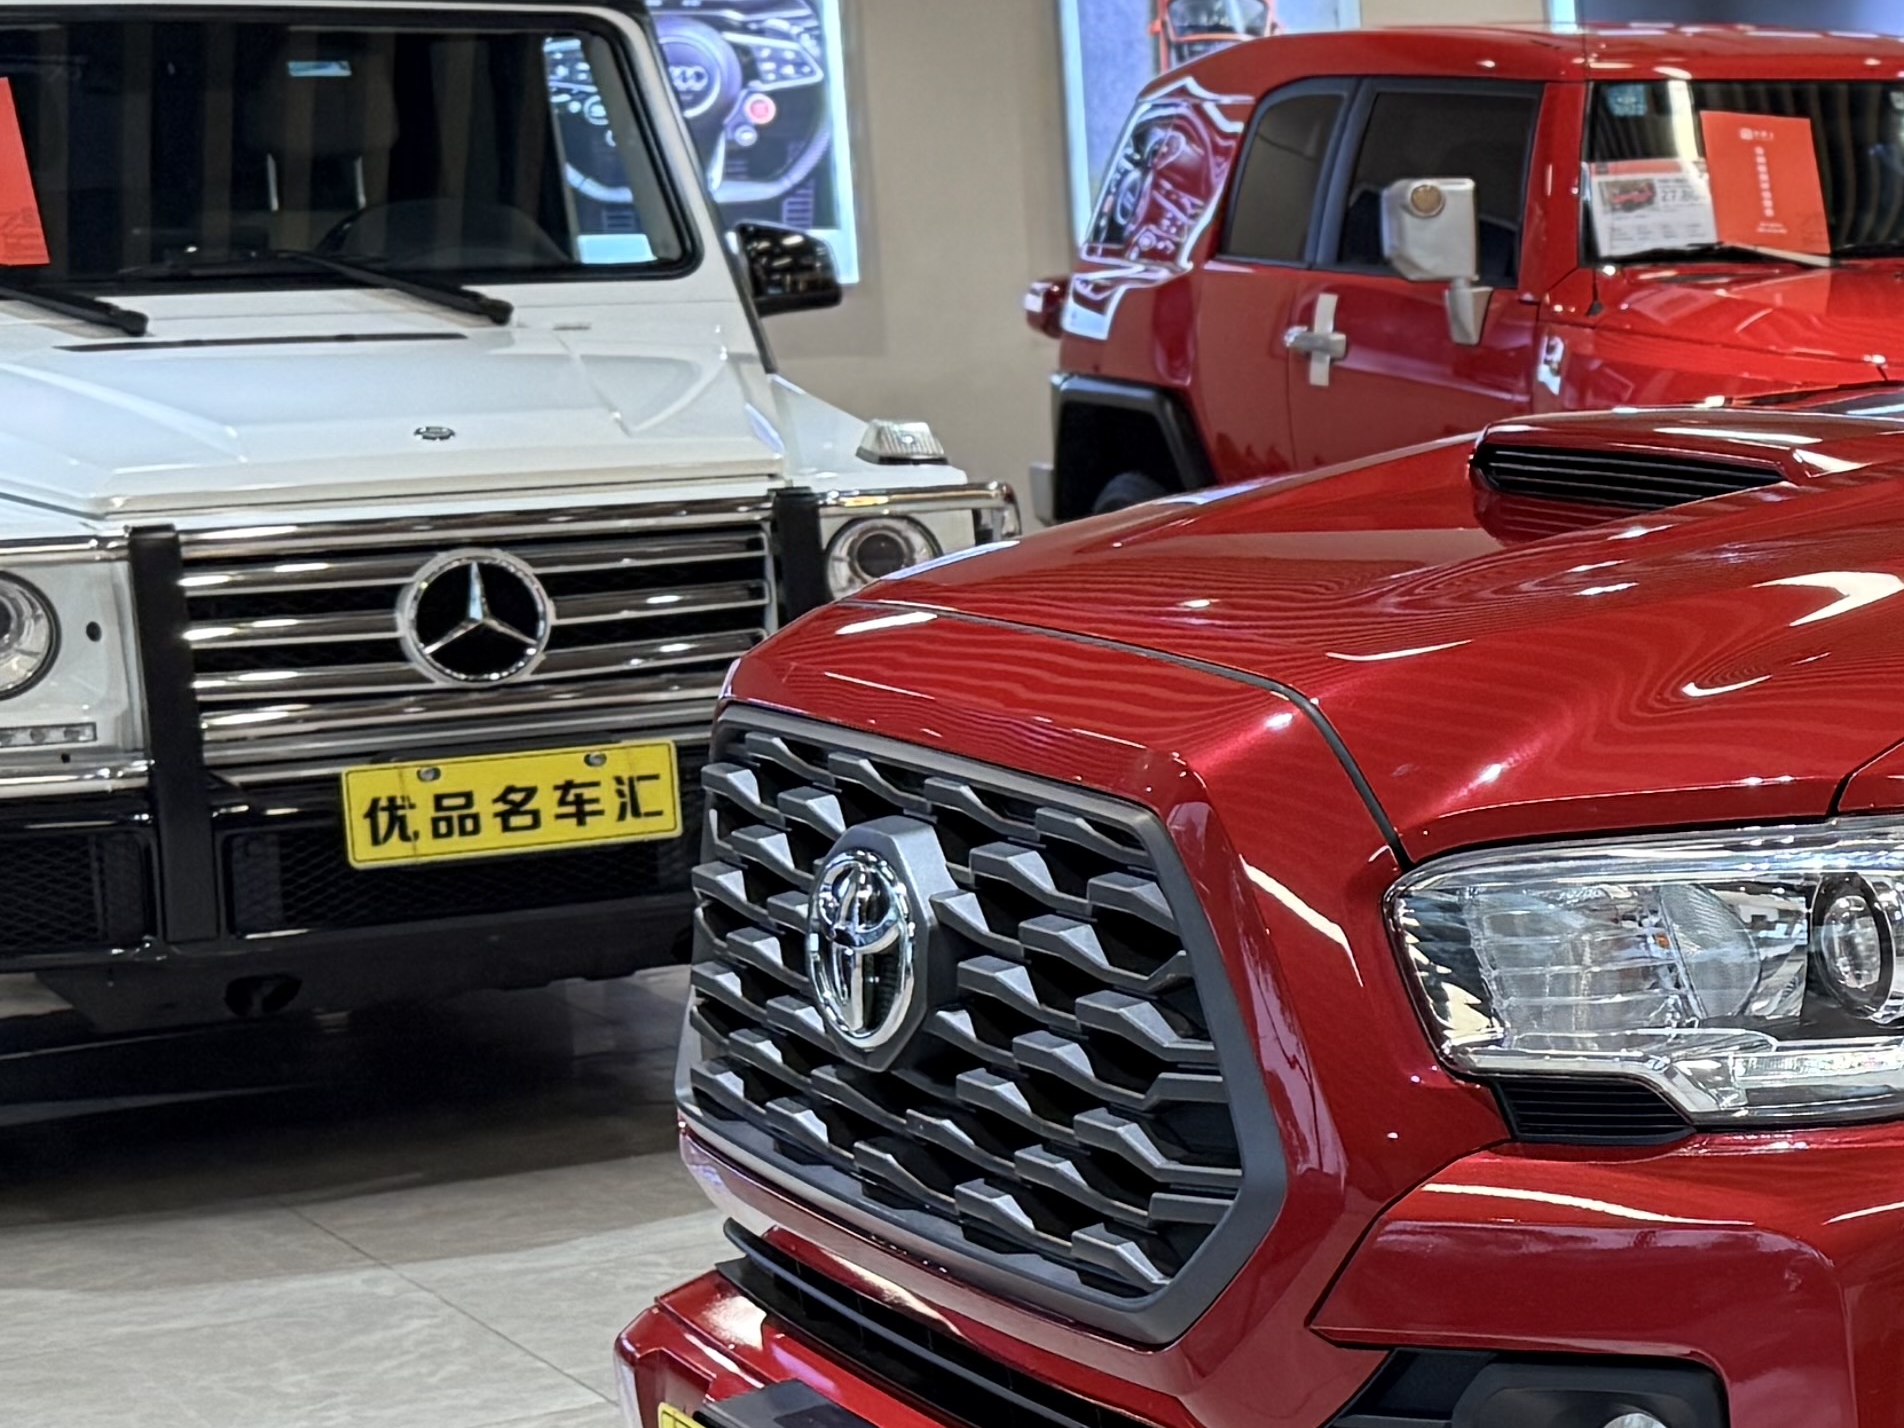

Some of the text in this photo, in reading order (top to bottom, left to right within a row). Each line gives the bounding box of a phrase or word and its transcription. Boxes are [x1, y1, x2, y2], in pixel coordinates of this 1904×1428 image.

[363, 774, 664, 847] 优品名车汇
